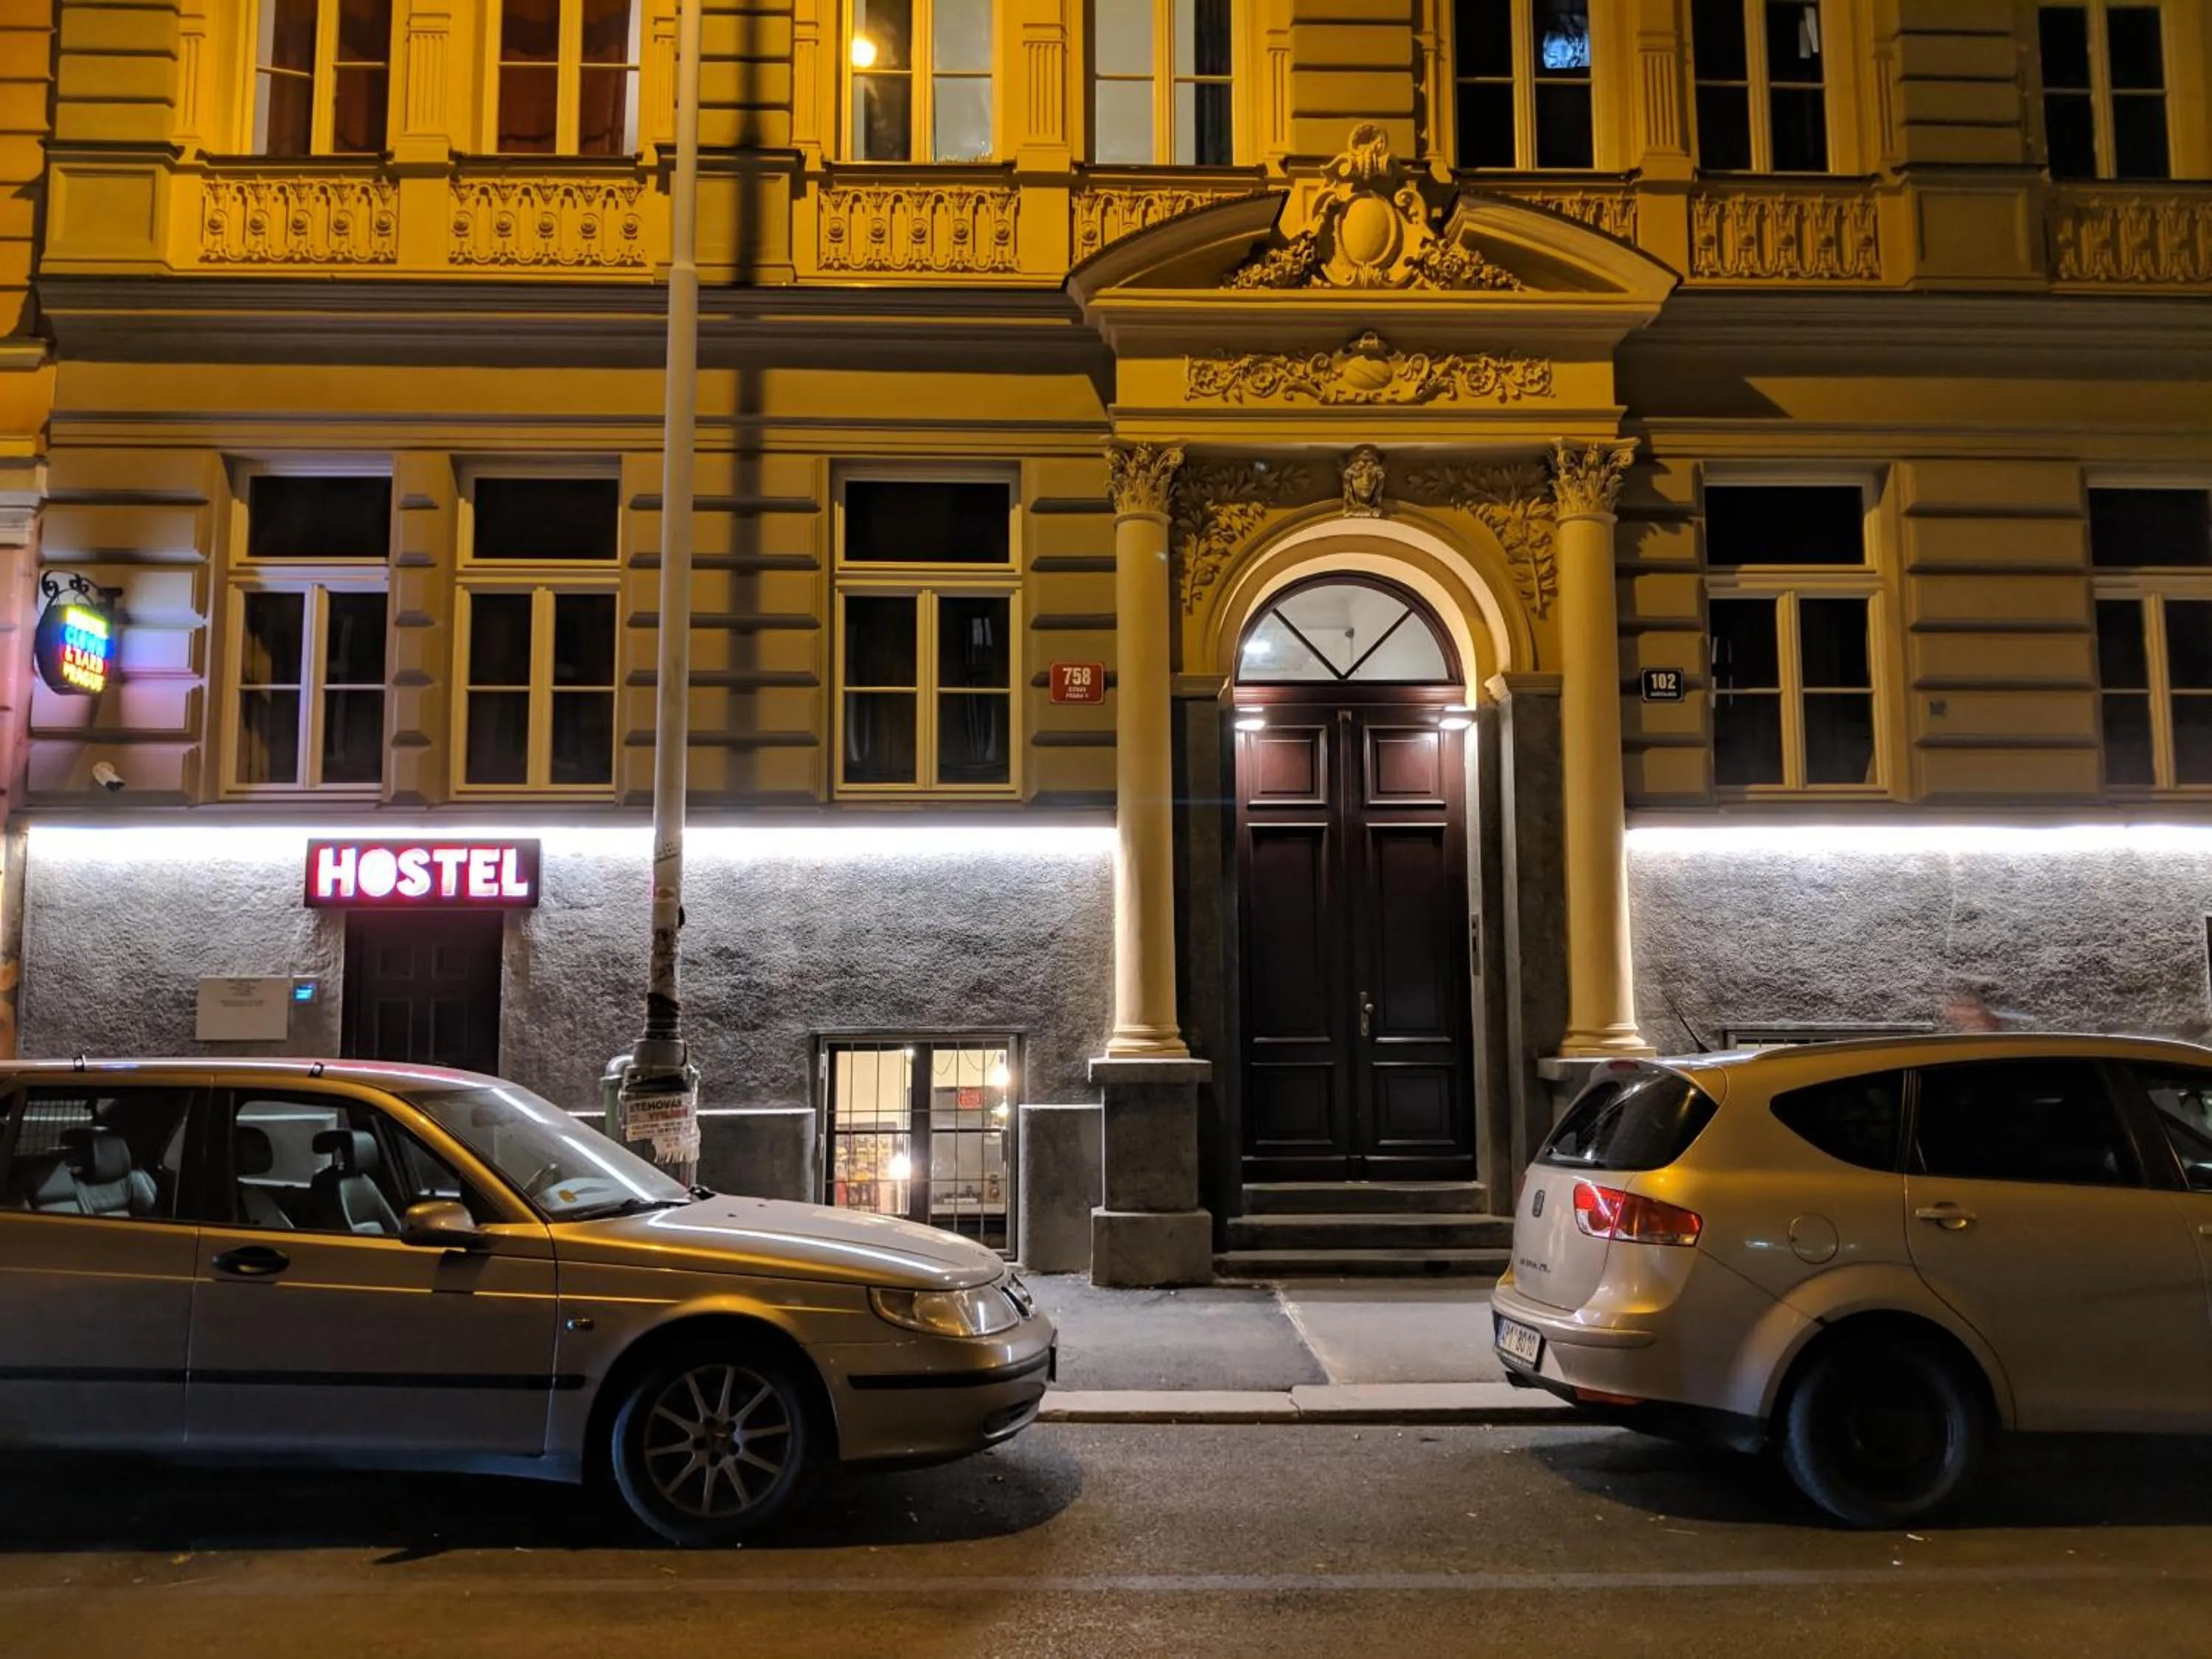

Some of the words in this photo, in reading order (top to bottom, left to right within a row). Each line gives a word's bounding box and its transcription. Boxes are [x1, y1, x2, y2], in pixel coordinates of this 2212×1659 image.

[1062, 667, 1091, 685] 758
[1651, 672, 1676, 689] 102
[317, 847, 529, 897] HOSTEL
